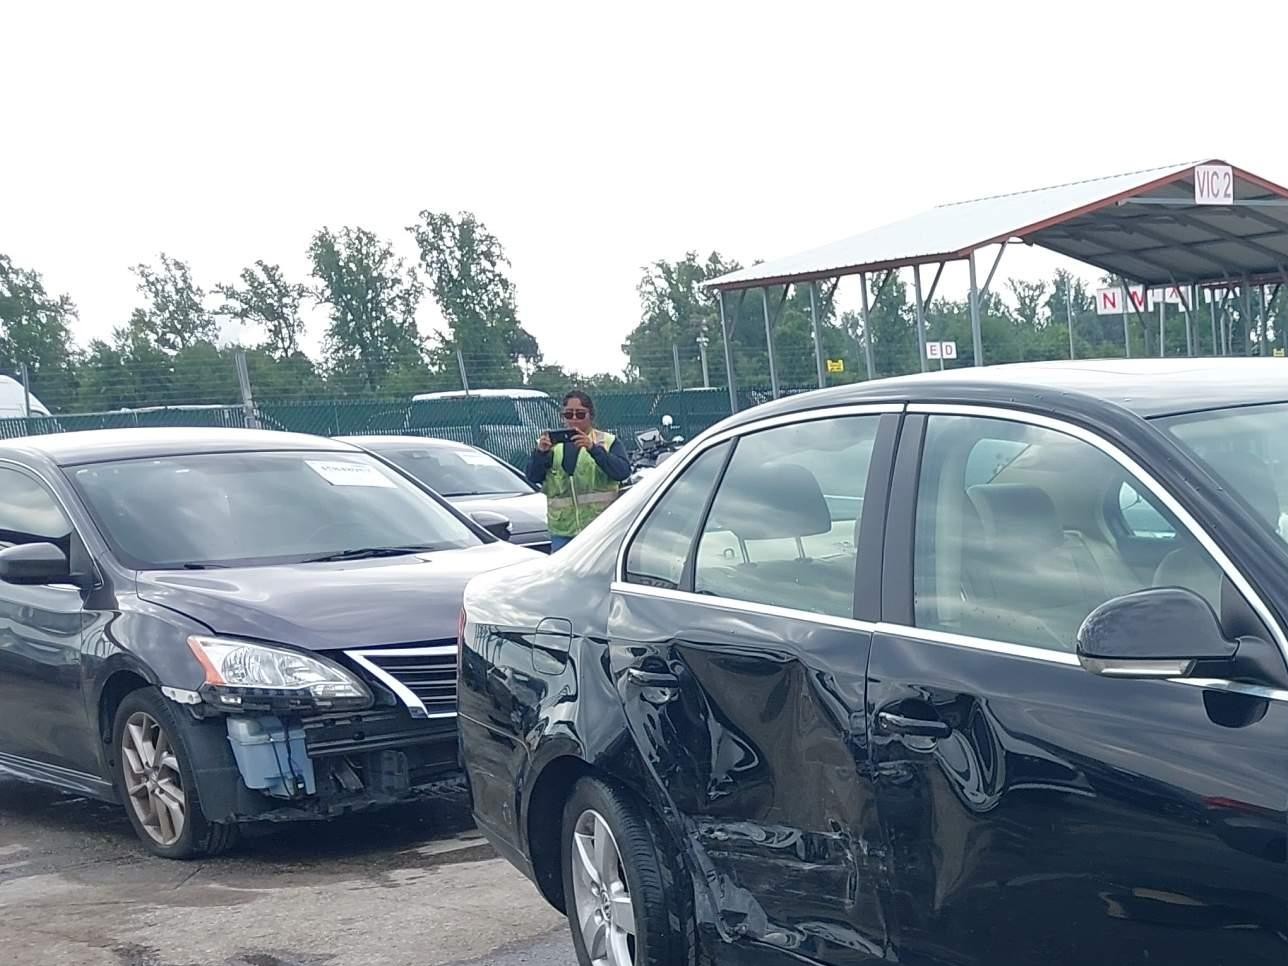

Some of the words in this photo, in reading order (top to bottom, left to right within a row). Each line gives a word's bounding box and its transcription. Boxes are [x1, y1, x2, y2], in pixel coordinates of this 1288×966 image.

[1197, 170, 1220, 199] VIC
[1223, 171, 1232, 199] 2
[1103, 292, 1116, 309] N
[929, 344, 937, 356] E
[945, 344, 953, 356] D
